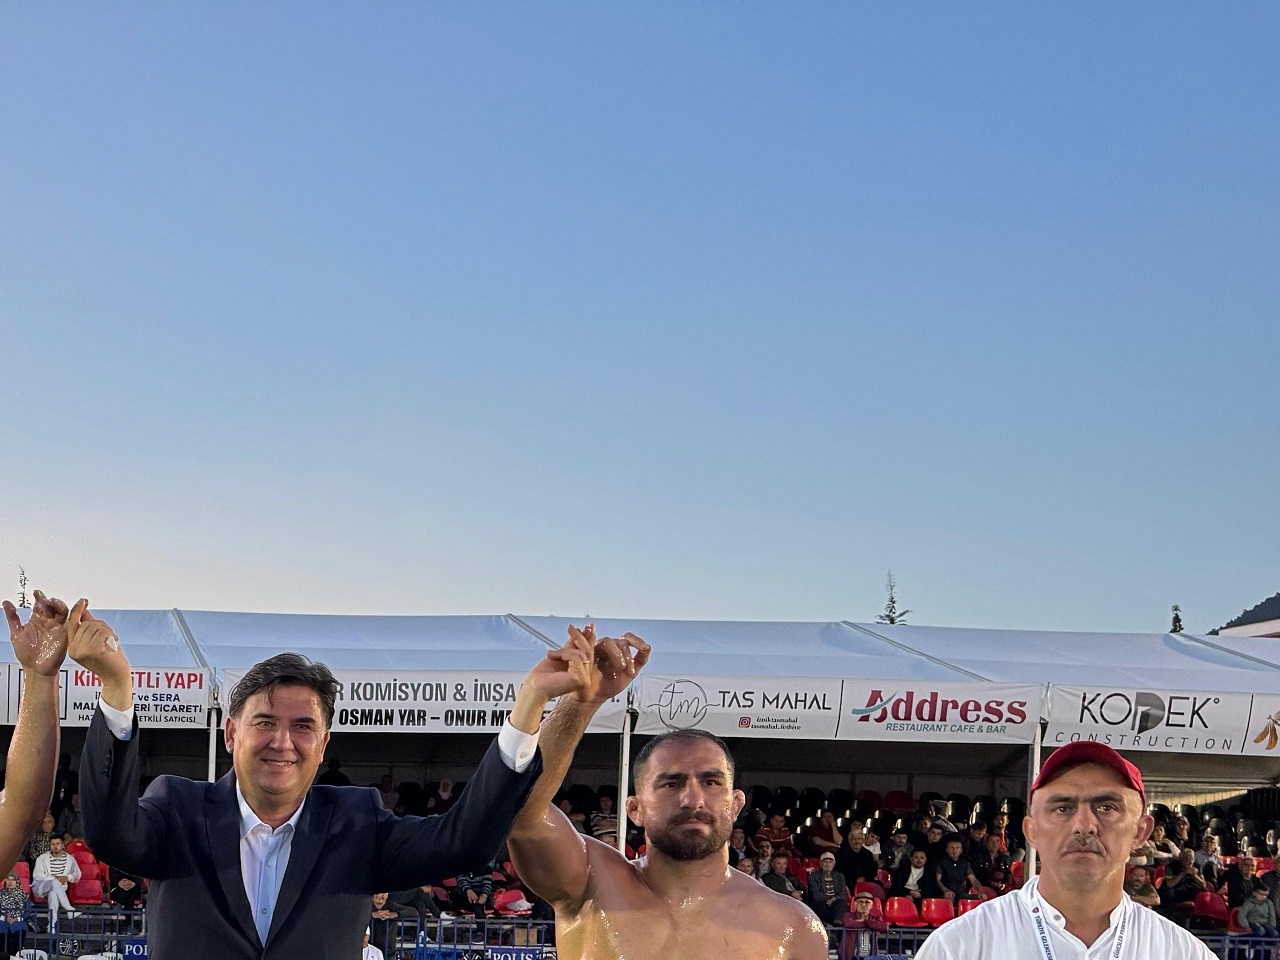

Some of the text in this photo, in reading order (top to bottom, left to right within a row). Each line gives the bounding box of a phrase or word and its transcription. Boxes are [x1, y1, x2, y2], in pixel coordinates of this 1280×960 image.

[164, 672, 204, 690] YAPI
[350, 678, 448, 701] KOMİSYON
[453, 683, 467, 701] &
[137, 694, 150, 702] ve
[152, 693, 181, 702] SERA
[719, 691, 832, 711] TAS MAHAL
[153, 704, 202, 713] TİCARETİ
[855, 690, 1028, 725] Address
[138, 714, 196, 723] ETKİLİ SATICISI
[338, 708, 394, 726] OSMAN
[398, 709, 427, 726] YAR
[444, 709, 487, 727] ONUR
[885, 722, 1007, 734] RESTAURANT CAFE & BAR
[1055, 731, 1233, 750] CONSTRUCTION
